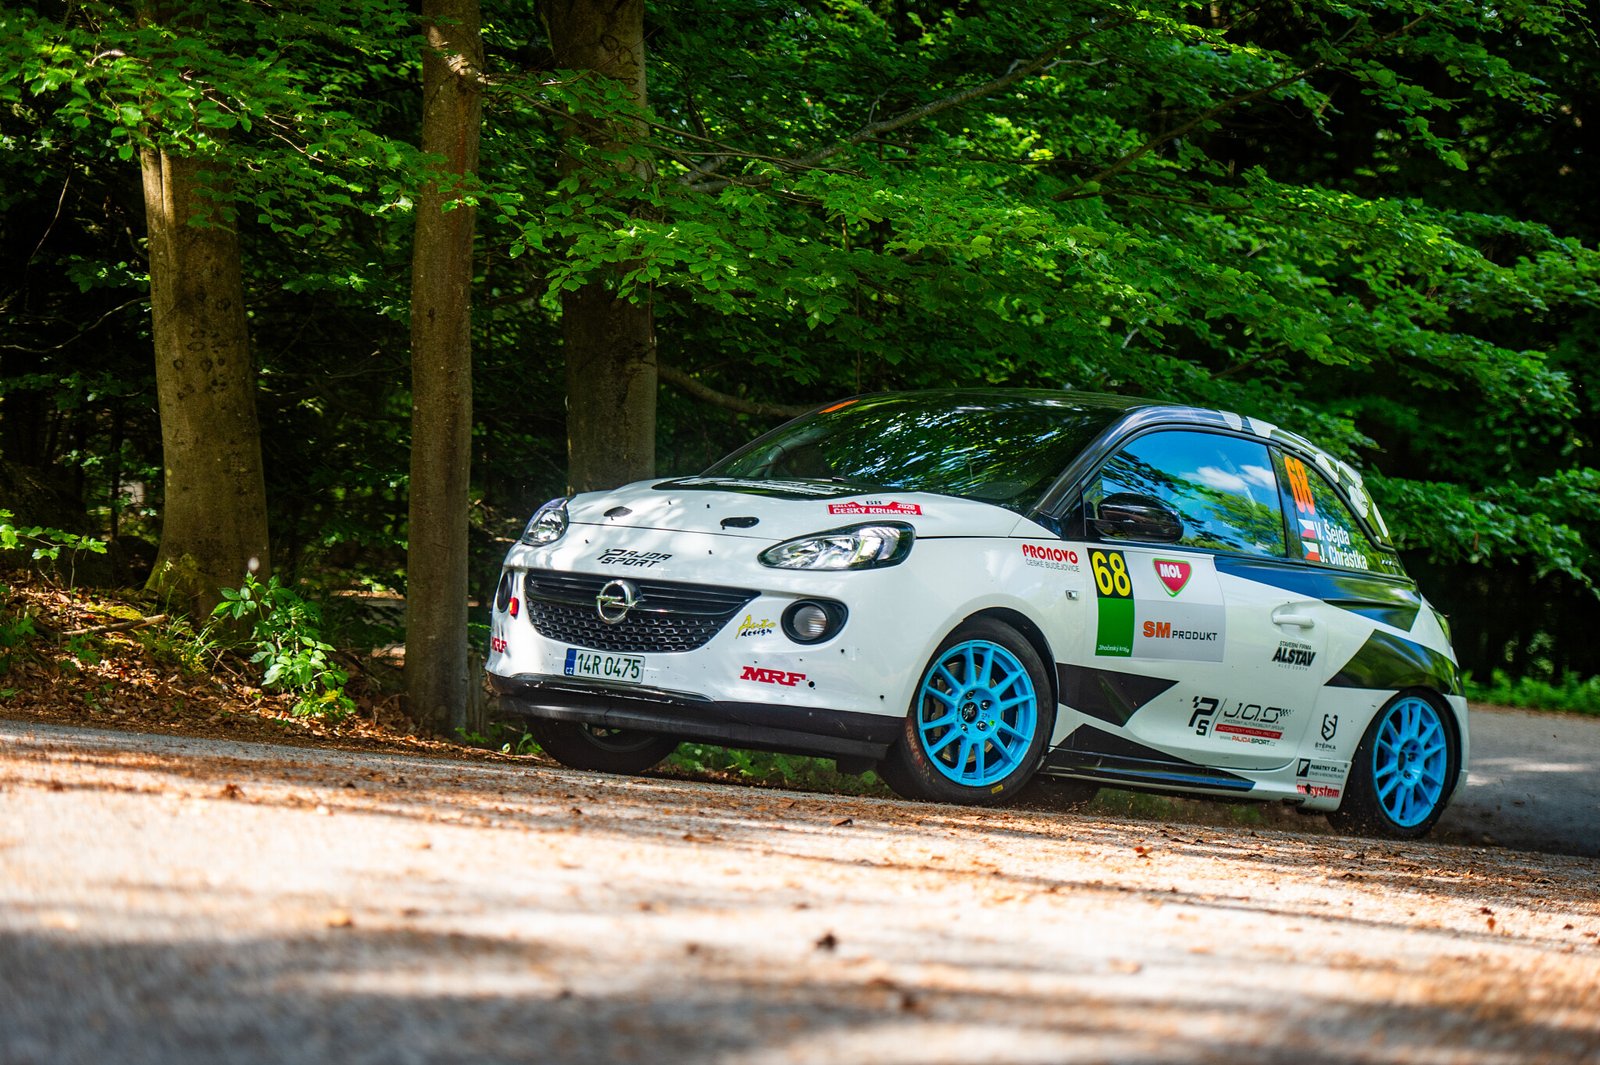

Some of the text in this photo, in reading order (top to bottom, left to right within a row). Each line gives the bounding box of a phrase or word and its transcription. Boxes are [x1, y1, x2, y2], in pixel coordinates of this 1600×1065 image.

[601, 557, 660, 568] SPORT
[1159, 563, 1183, 579] MOL
[1091, 551, 1131, 597] 68
[735, 615, 776, 639] Auto
[741, 627, 772, 637] design
[1143, 620, 1218, 641] SM PRODUKT
[578, 653, 602, 675] 14R
[604, 656, 641, 679] 0475
[1271, 646, 1317, 667] ALSTAV
[740, 666, 806, 686] MRF
